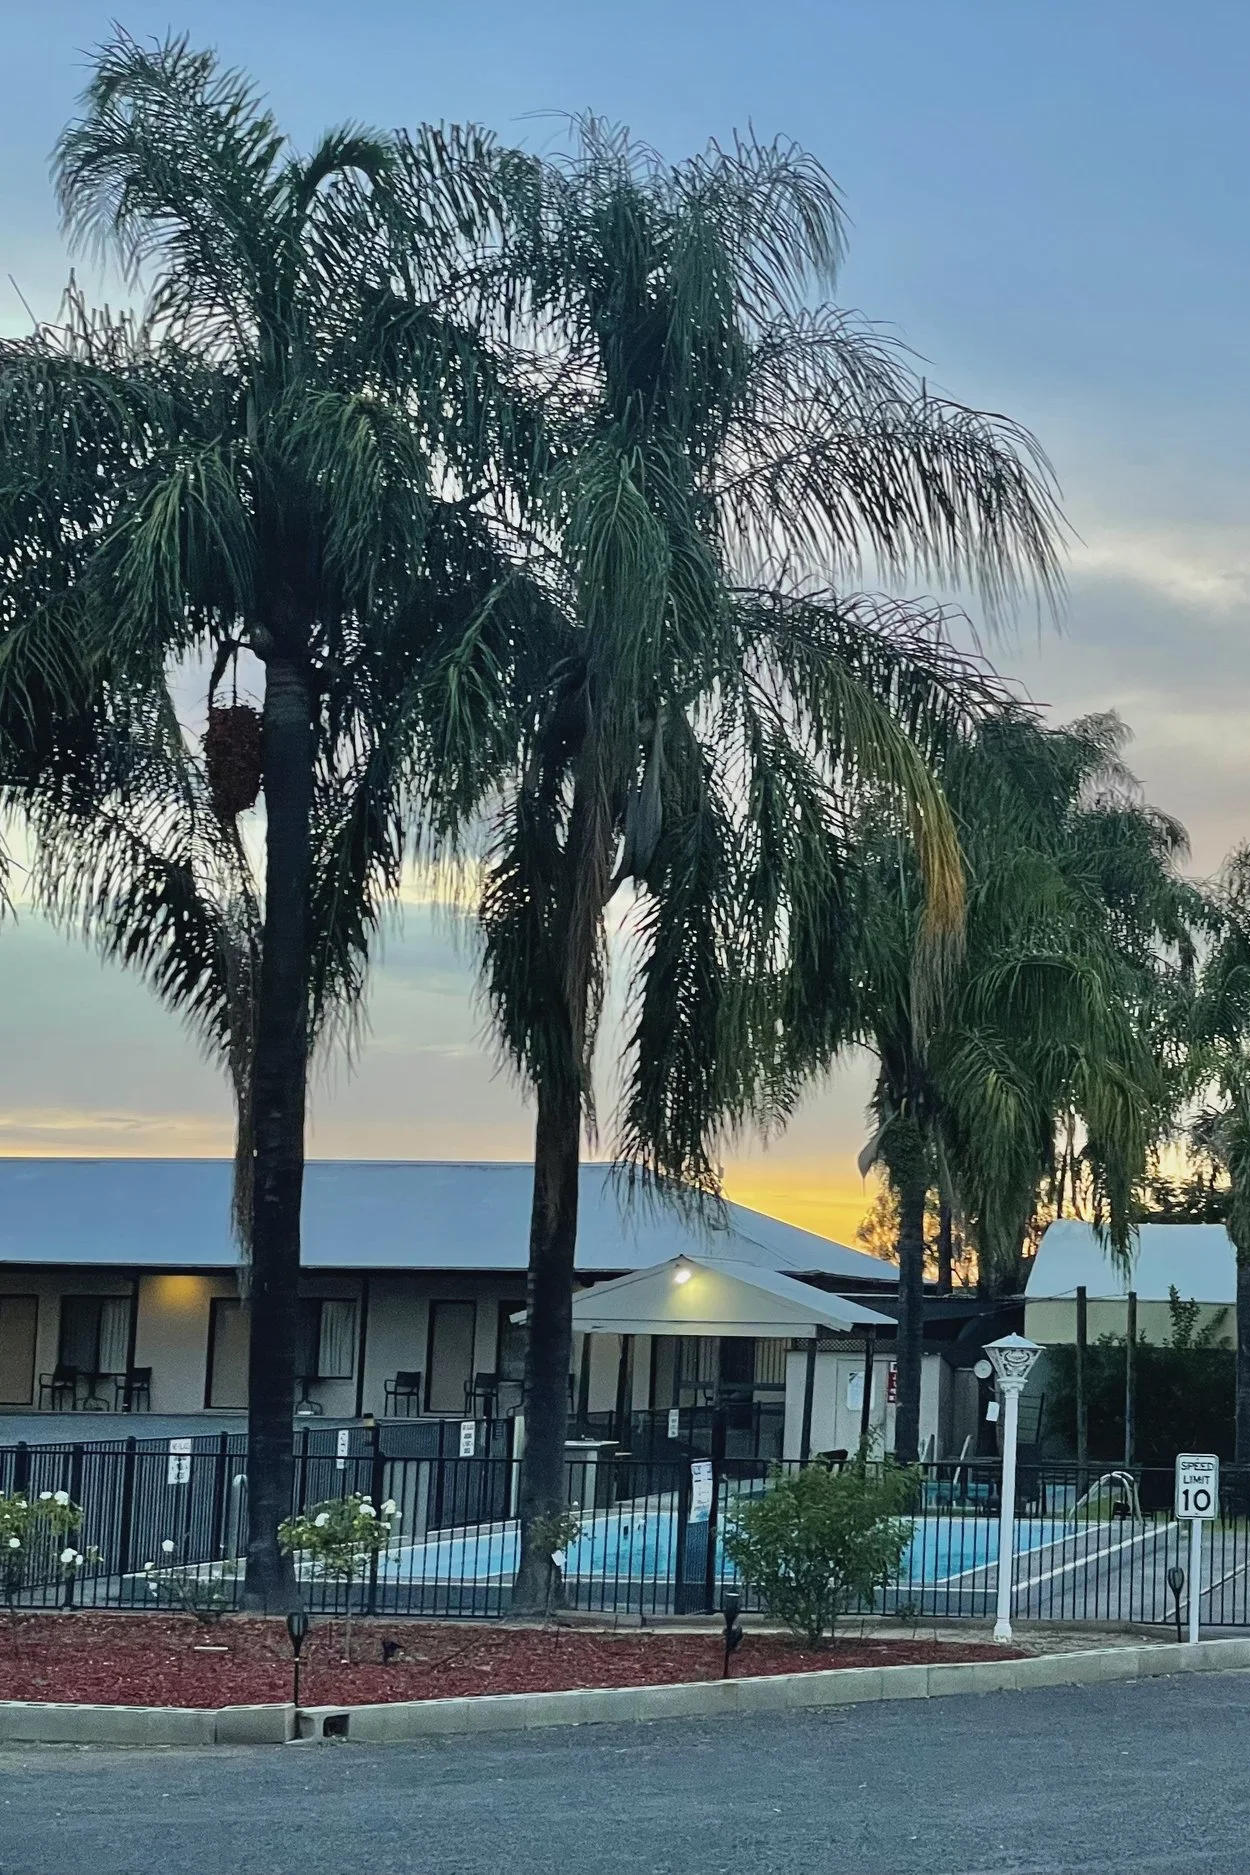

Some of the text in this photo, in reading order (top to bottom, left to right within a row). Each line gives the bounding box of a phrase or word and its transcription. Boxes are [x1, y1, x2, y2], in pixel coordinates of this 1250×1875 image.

[1181, 1461, 1214, 1471] SPEED
[1183, 1475, 1210, 1485] LIMIT
[1182, 1488, 1211, 1512] 10
